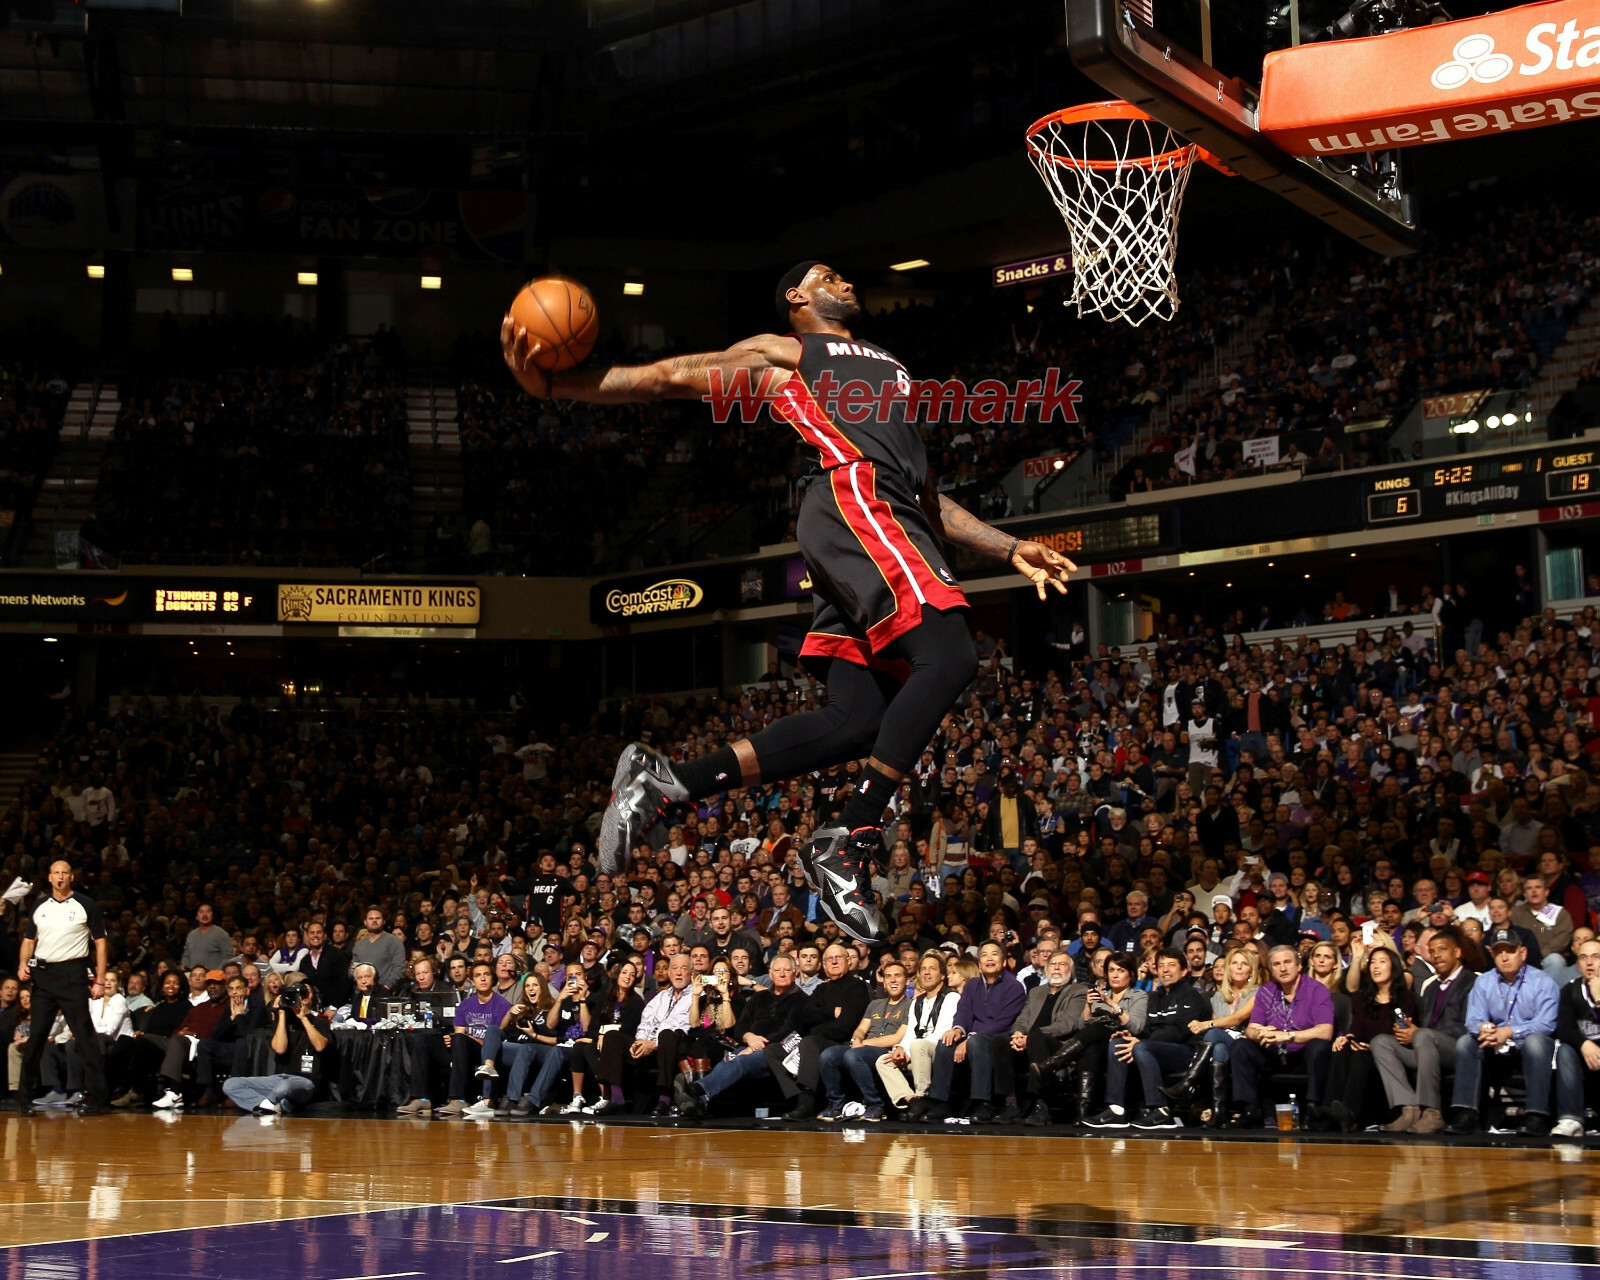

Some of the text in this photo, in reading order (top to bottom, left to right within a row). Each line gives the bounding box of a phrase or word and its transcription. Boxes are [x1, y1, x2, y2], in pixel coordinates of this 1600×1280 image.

[300, 215, 457, 243] FAN ZONE
[996, 263, 1049, 283] Snacks
[1053, 257, 1067, 271] &
[825, 341, 908, 373] MIA
[1426, 397, 1457, 419] 202
[1026, 459, 1050, 477] 201
[1553, 452, 1594, 468] GUEST
[1375, 477, 1412, 491] KINGS
[1433, 465, 1473, 486] 5:22
[1445, 485, 1520, 506] #KingsAllDay
[1396, 496, 1408, 514] 6
[1559, 504, 1583, 519] 103
[1032, 530, 1082, 552] NGS!
[1106, 561, 1126, 575] 102
[31, 593, 86, 606] Networks
[166, 590, 217, 601] THUNDER
[316, 588, 476, 607] SACRAMENTO KINGS
[606, 586, 673, 613] Comcast
[622, 598, 690, 616] SPORTSNET
[338, 612, 454, 624] FOUNDATION
[533, 884, 558, 894] HEAT
[546, 895, 554, 905] 6
